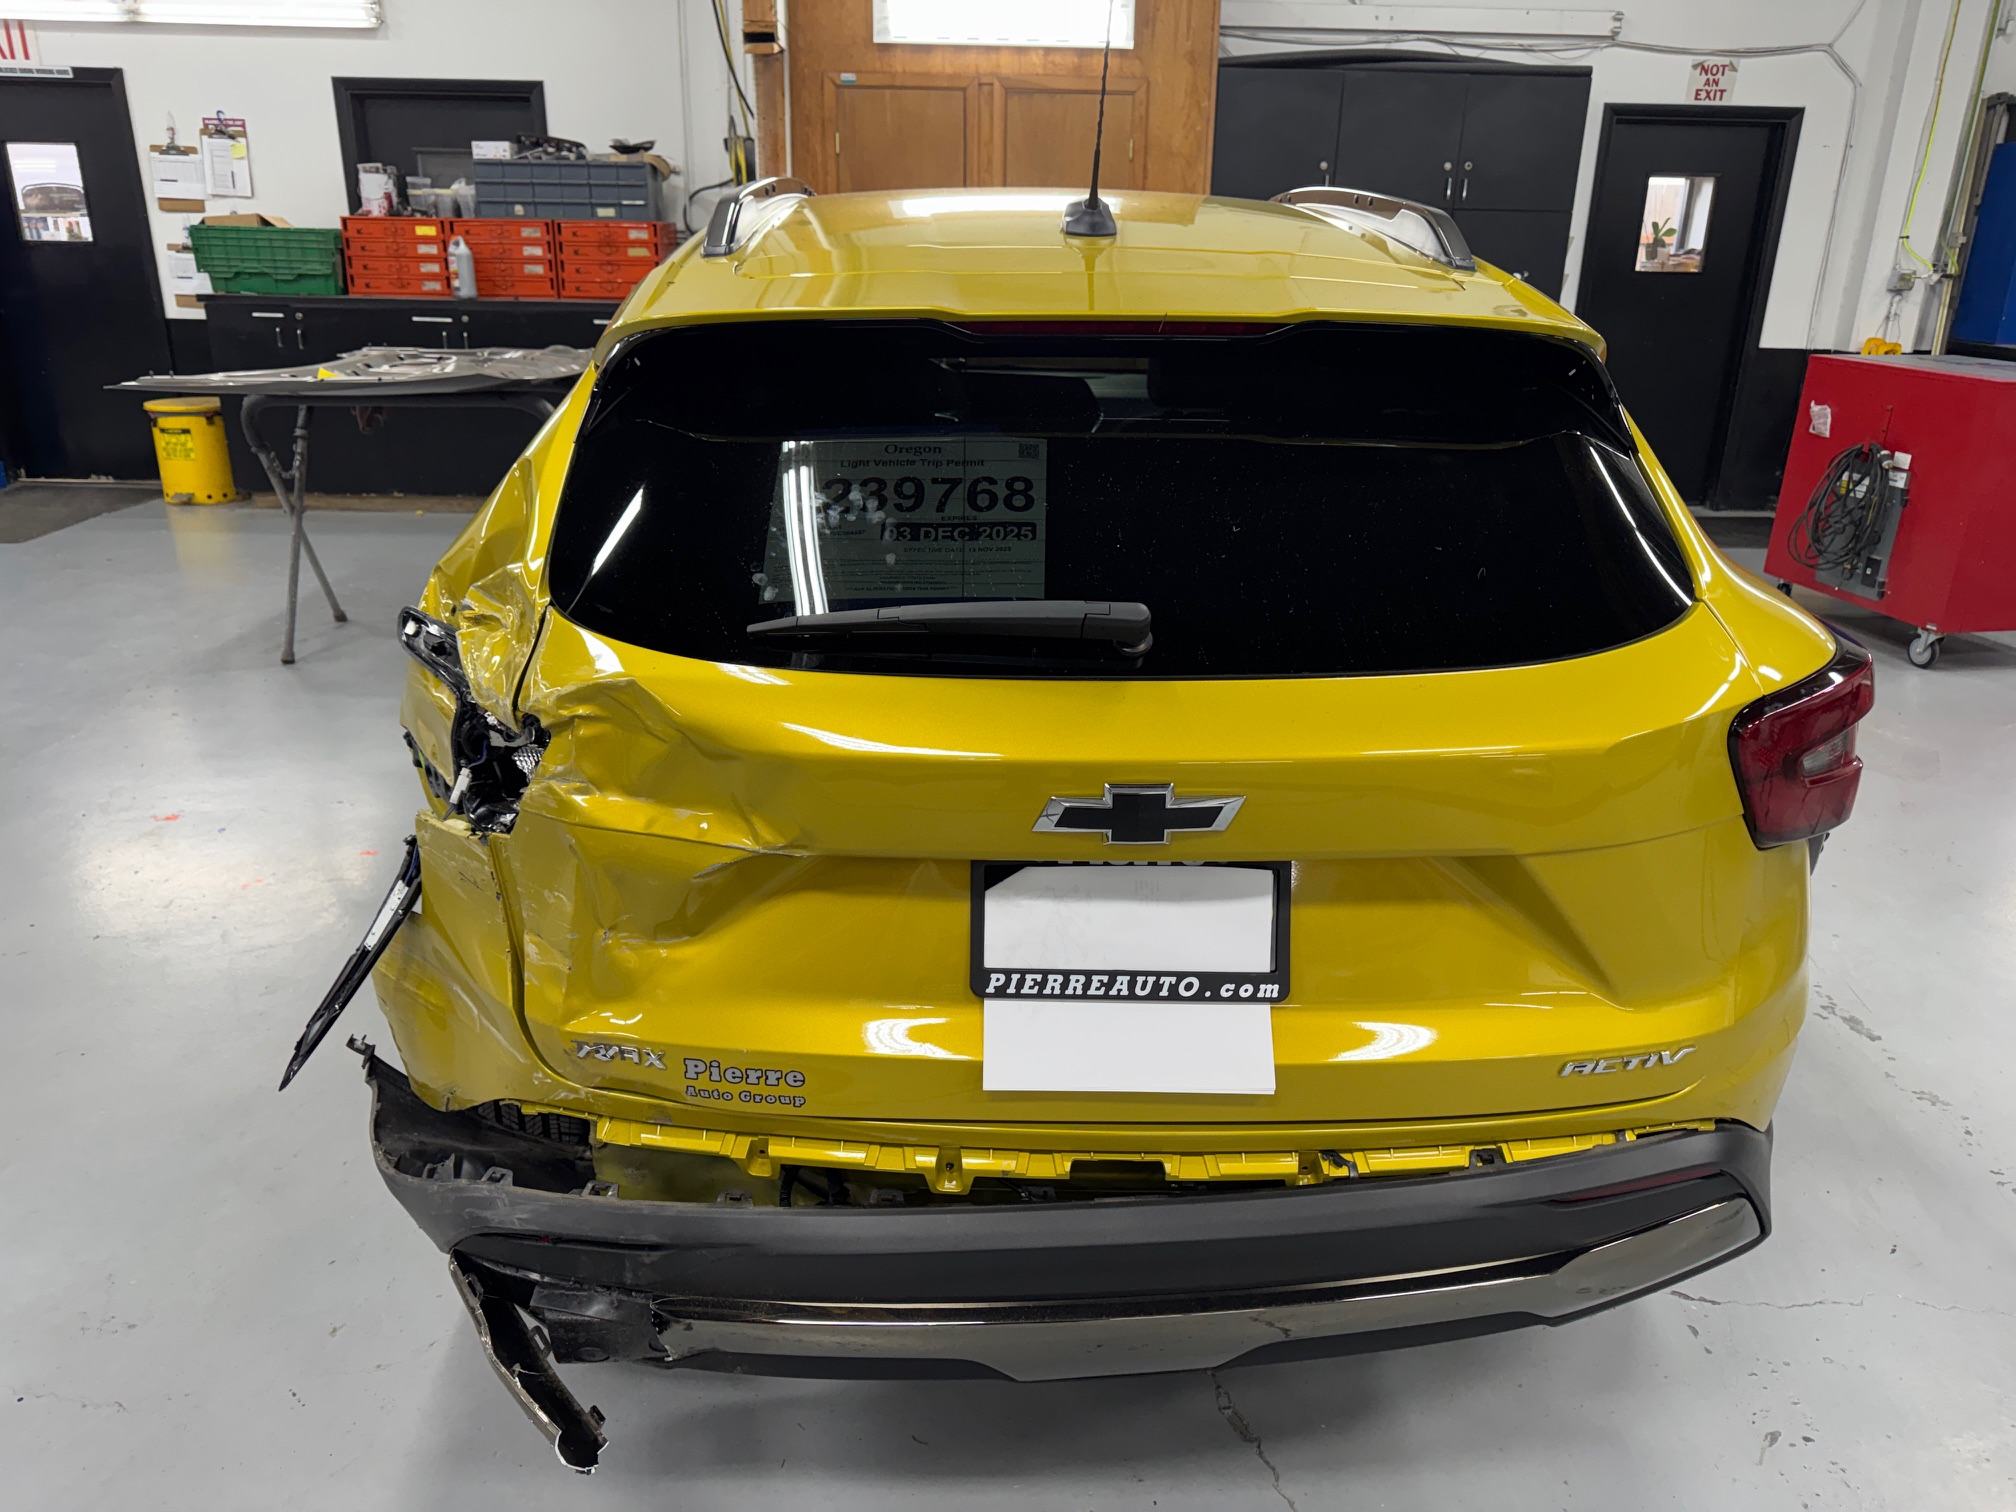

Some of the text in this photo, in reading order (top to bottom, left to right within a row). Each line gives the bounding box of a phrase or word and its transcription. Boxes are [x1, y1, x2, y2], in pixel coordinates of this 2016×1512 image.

[1699, 64, 1729, 76] NOT
[1703, 78, 1720, 88] AN
[1694, 89, 1727, 101] EXIT
[884, 444, 942, 456] Oregon
[840, 458, 985, 469] Light Vehicle Trip Permit
[821, 476, 1035, 514] 239768
[941, 514, 978, 522] EXPIRES
[887, 526, 1034, 541] 03 DEC 2025
[985, 973, 1280, 998] PIERREAUTO.com
[1558, 1045, 1697, 1077] ACTIV
[684, 1058, 806, 1088] Pierre
[686, 1086, 807, 1108] Auto Group
